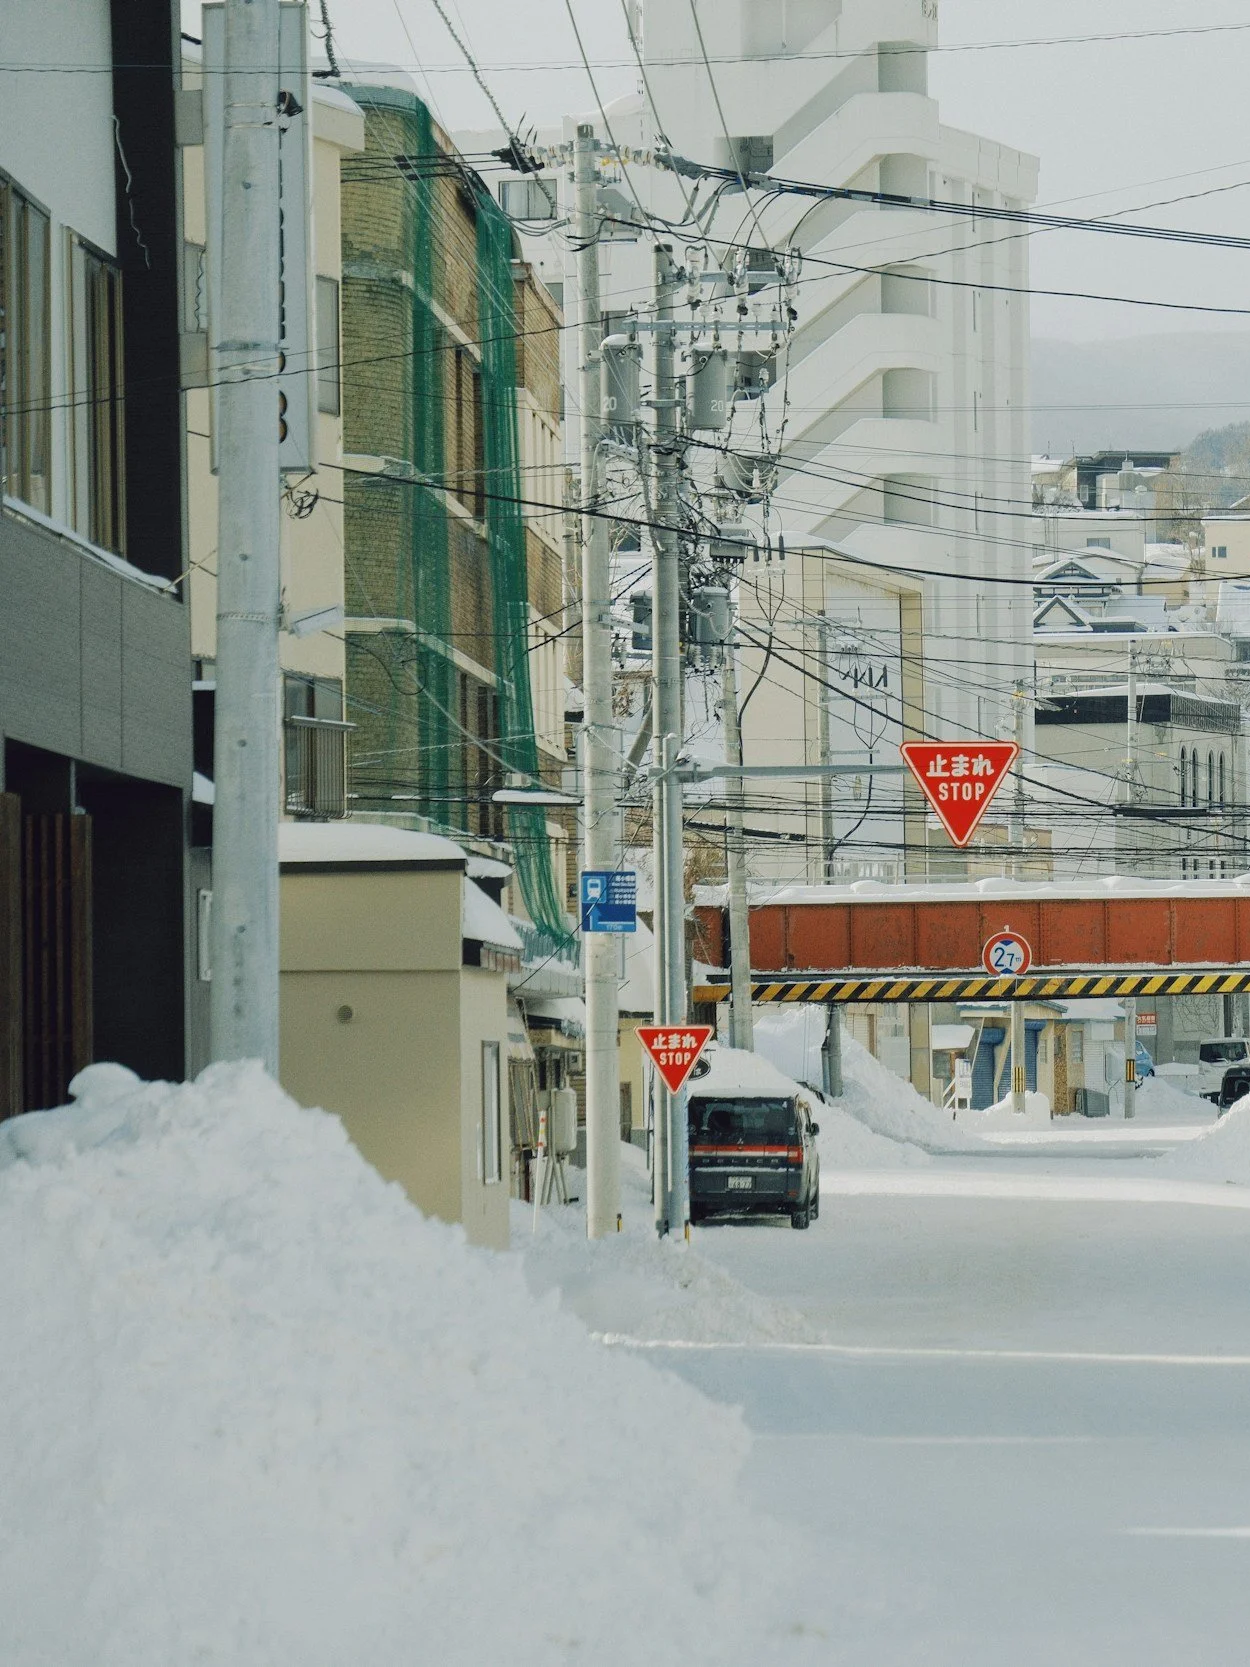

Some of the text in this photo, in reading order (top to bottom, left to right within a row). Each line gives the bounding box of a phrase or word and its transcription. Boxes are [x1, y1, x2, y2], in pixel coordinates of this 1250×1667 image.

[602, 396, 618, 411] 20
[710, 399, 724, 412] 20
[926, 754, 994, 778] 止まれ
[938, 783, 985, 801] STOP
[651, 1033, 698, 1050] 止まれ
[659, 1052, 691, 1066] STOP
